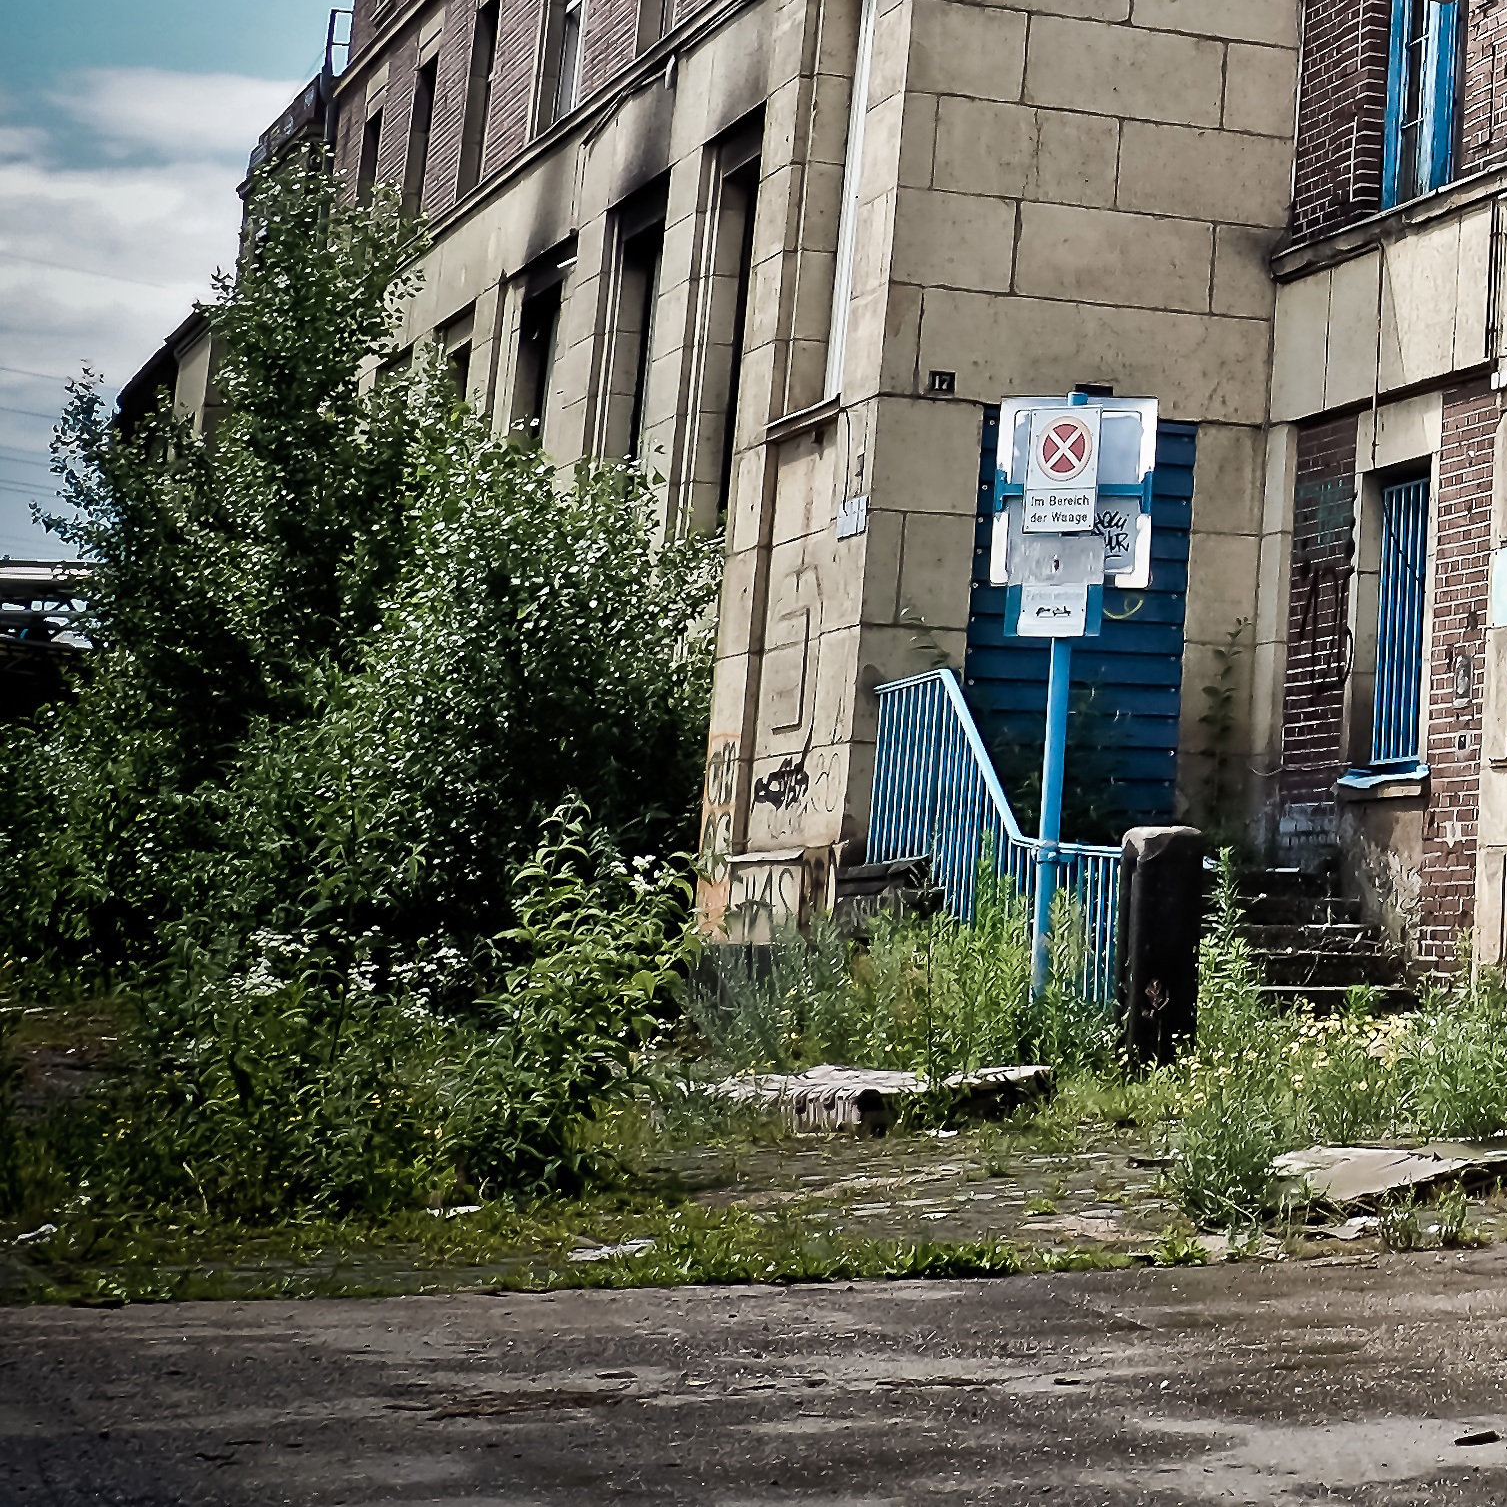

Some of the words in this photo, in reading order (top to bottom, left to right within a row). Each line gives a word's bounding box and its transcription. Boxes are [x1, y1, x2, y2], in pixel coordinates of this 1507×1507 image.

[934, 376, 951, 390] 17
[1031, 496, 1045, 507] Im
[1049, 495, 1090, 506] Bereich
[1030, 512, 1047, 523] der
[1051, 511, 1088, 524] Waage
